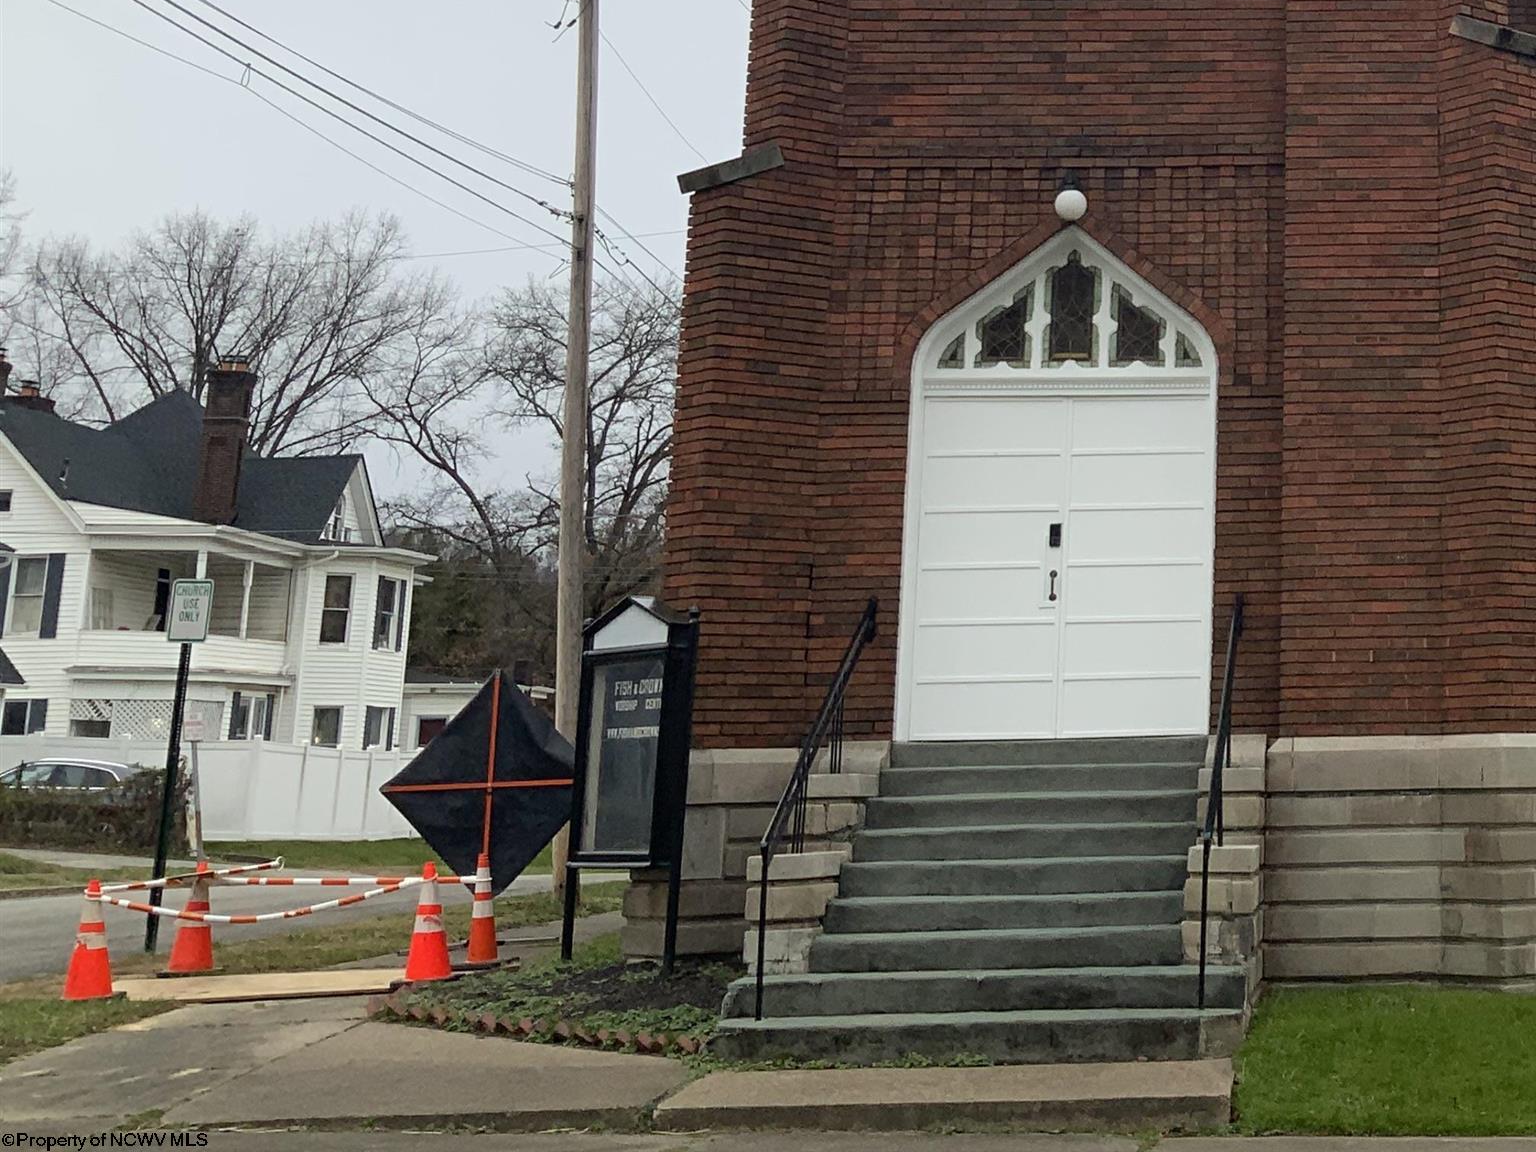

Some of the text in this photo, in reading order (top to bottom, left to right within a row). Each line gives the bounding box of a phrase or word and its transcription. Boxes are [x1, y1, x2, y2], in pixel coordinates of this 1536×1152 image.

[176, 585, 209, 597] CHURCH
[183, 598, 200, 610] USE
[178, 610, 200, 622] ONLY
[614, 680, 633, 696] FISH
